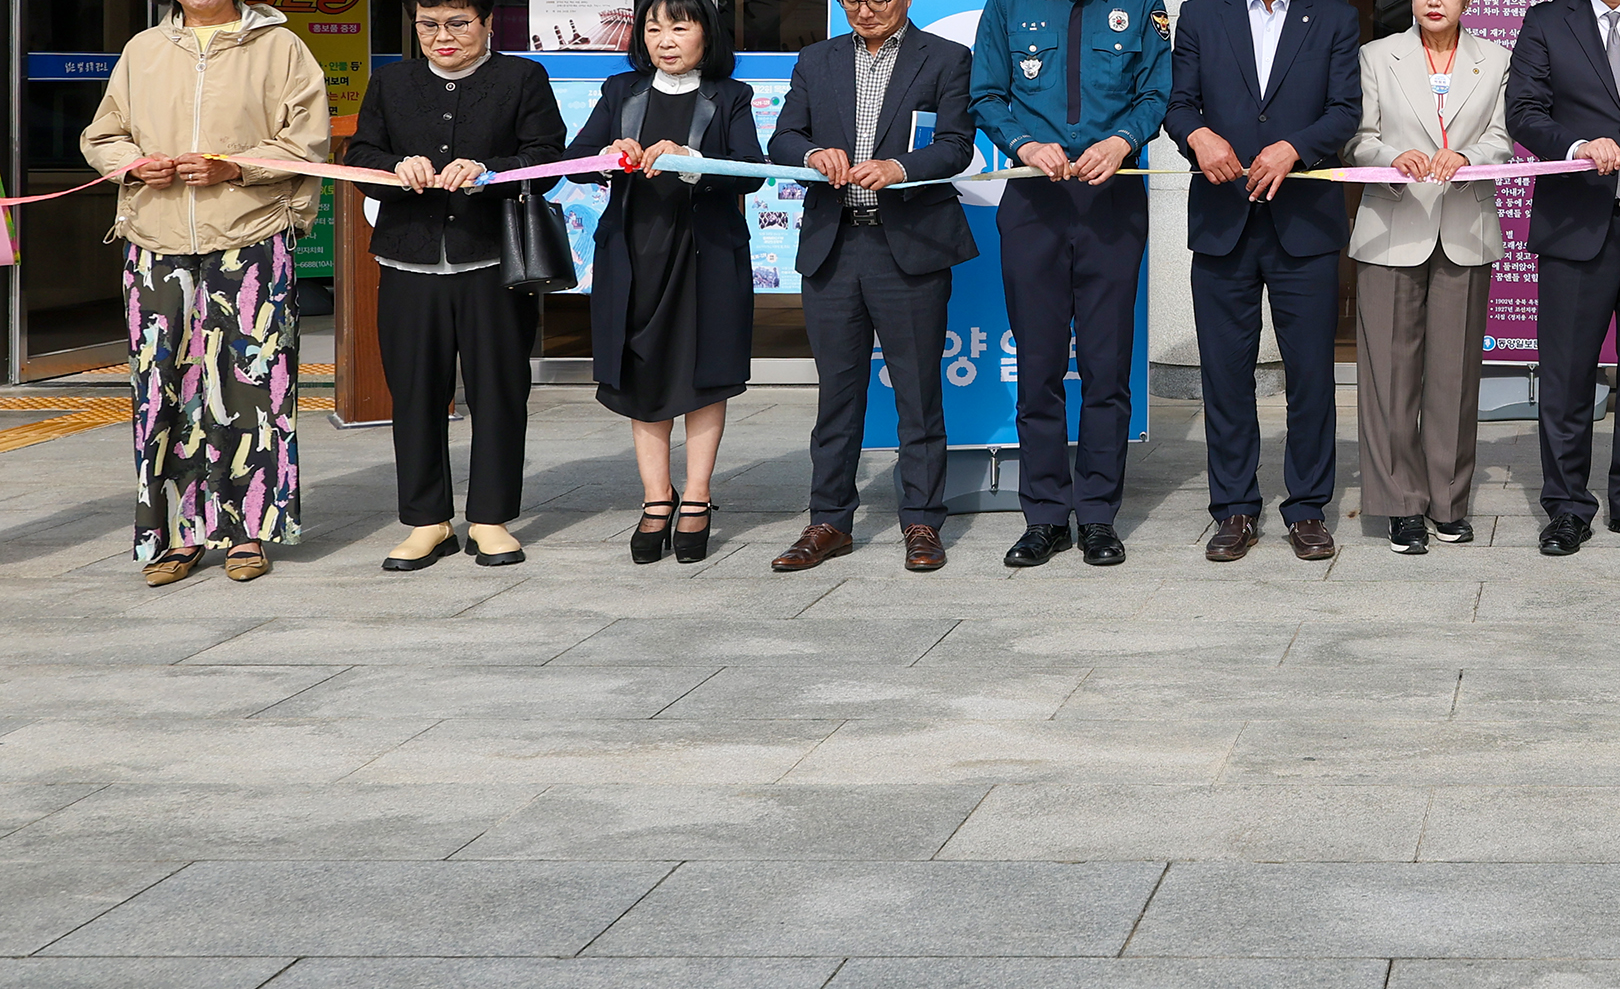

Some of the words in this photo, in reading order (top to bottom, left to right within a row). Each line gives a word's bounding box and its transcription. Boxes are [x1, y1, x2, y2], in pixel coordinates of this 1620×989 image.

[1483, 7, 1500, 17] 차마
[340, 91, 360, 101] 시간
[1501, 187, 1526, 197] 아내가
[1497, 209, 1522, 219] 꿈엔들
